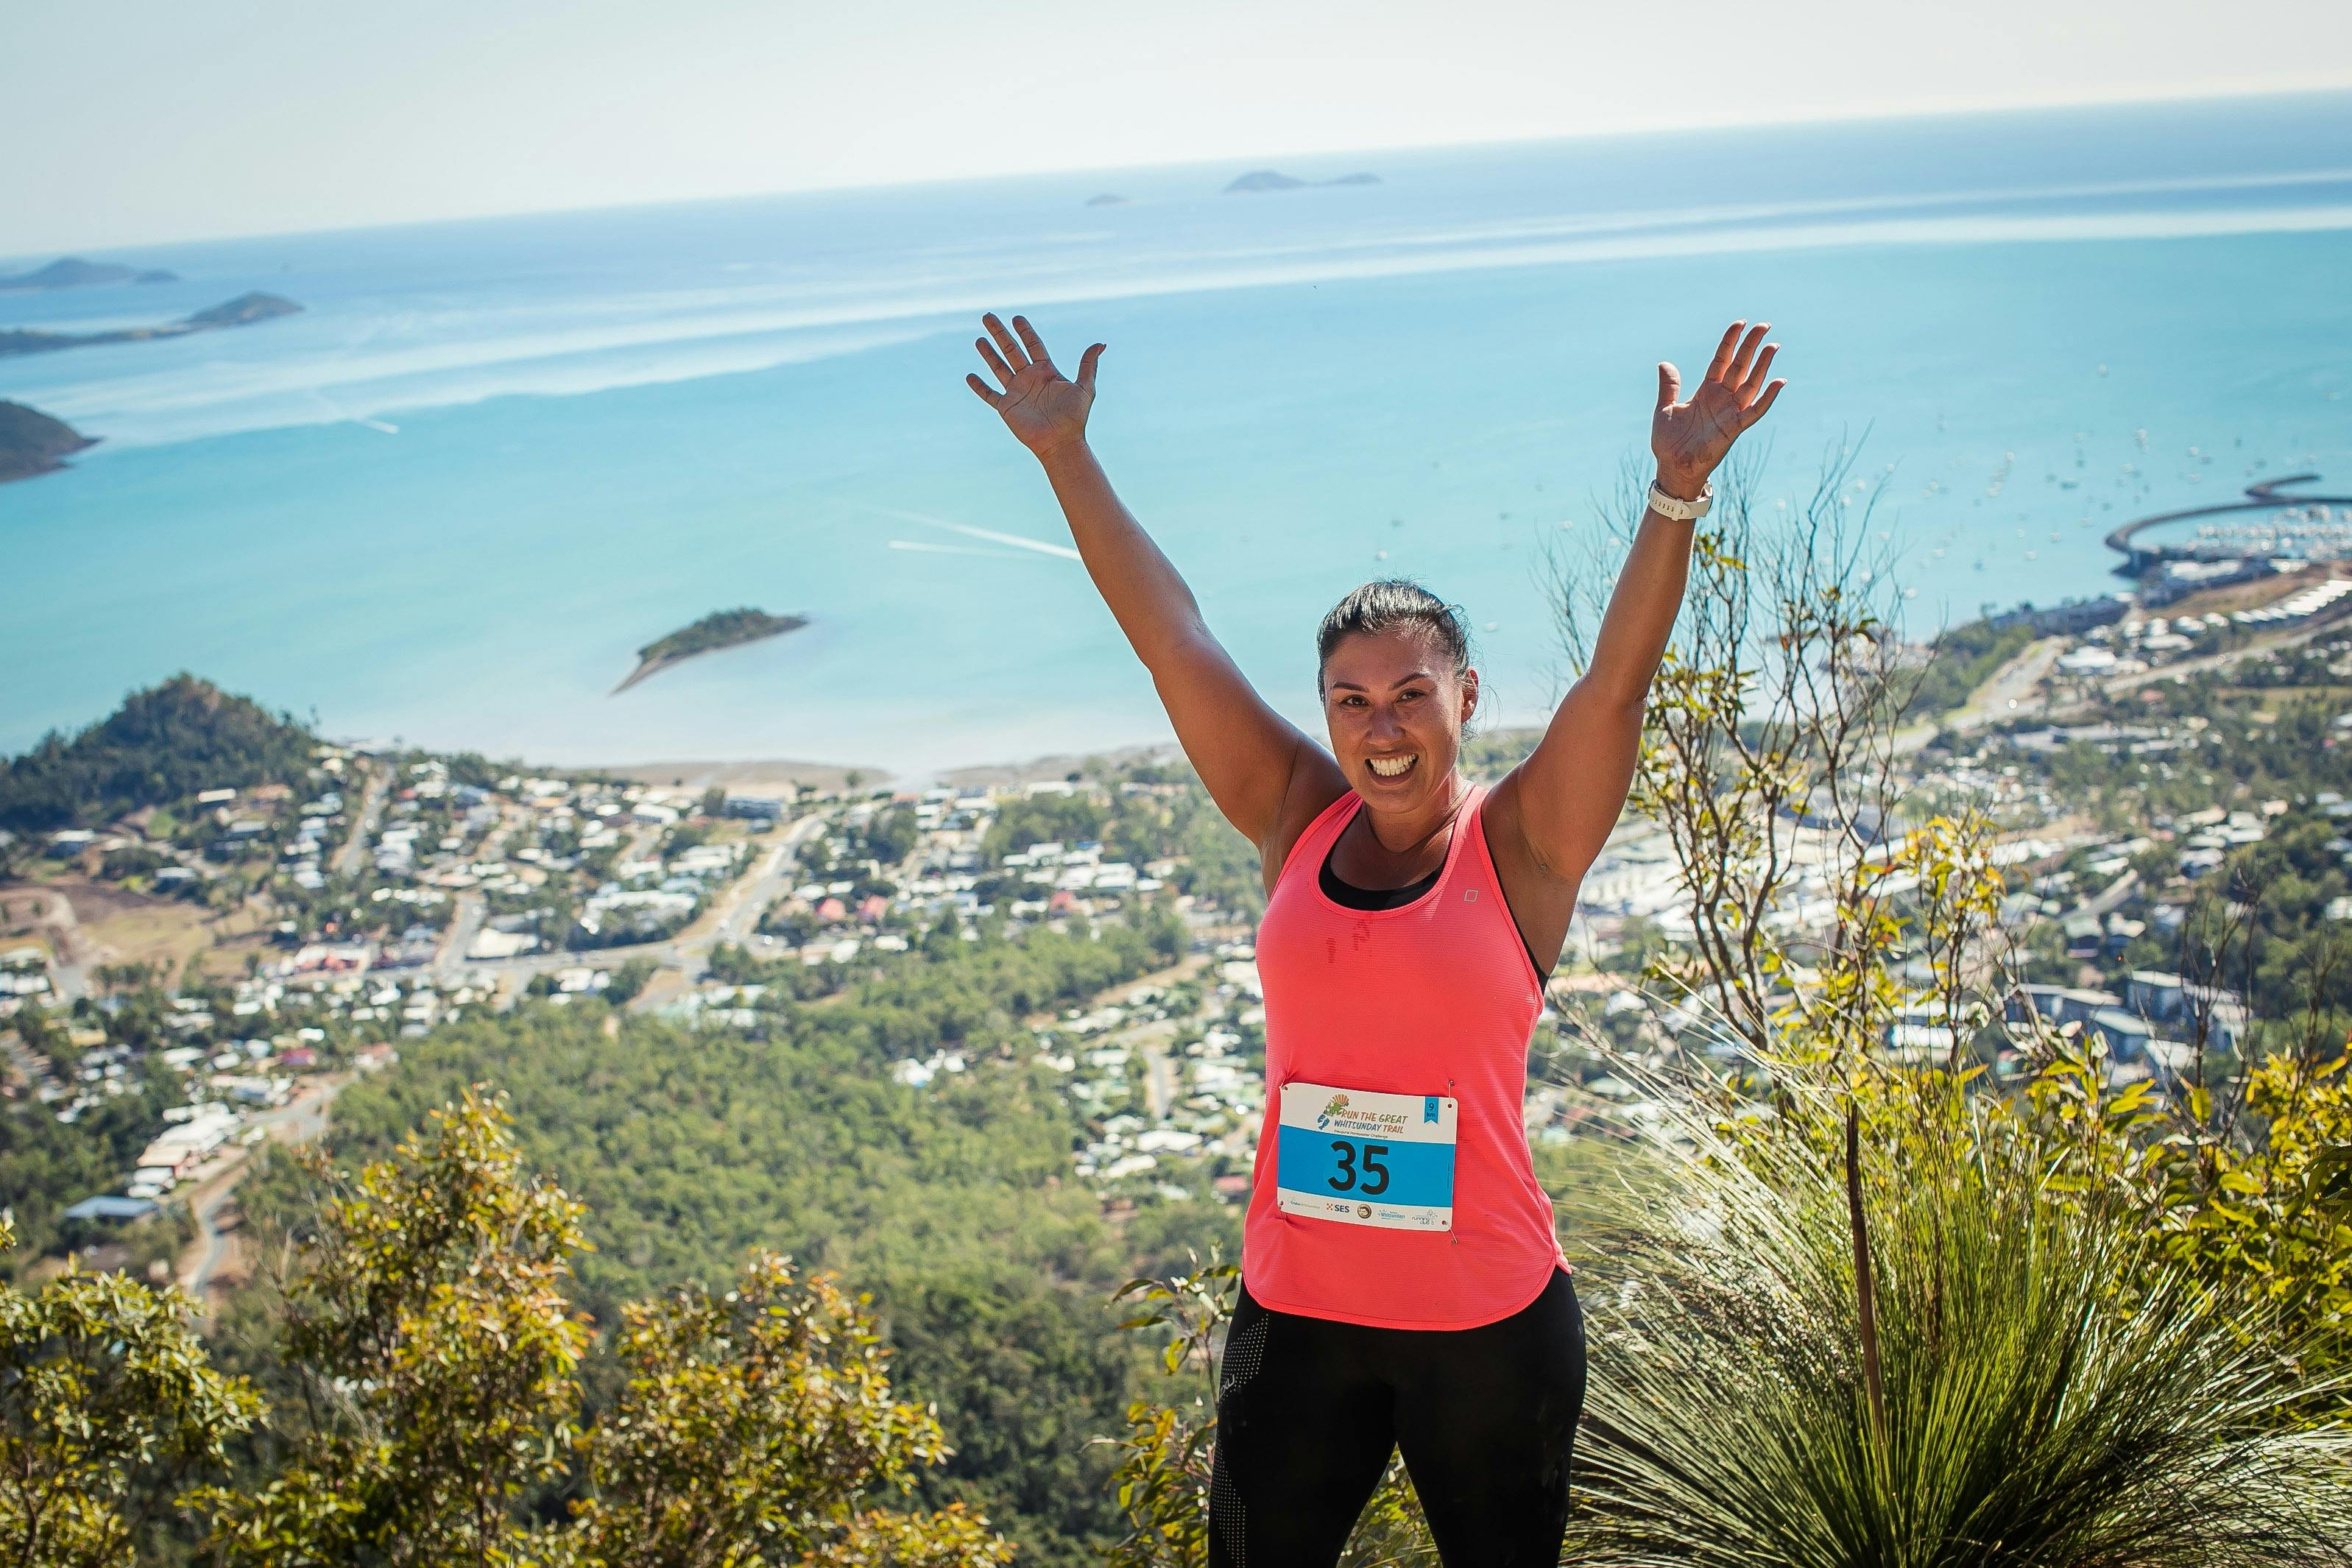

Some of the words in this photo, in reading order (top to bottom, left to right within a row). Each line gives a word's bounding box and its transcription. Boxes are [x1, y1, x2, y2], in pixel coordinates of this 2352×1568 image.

[1429, 1103, 1434, 1111] 9
[1341, 1109, 1359, 1119] RUN
[1360, 1112, 1377, 1121] THE
[1379, 1114, 1408, 1125] GREAT
[1334, 1120, 1382, 1131] WHITSUNDAY
[1382, 1125, 1404, 1134] TRAIL
[1327, 1140, 1390, 1196] 35
[1334, 1204, 1350, 1213] SES
